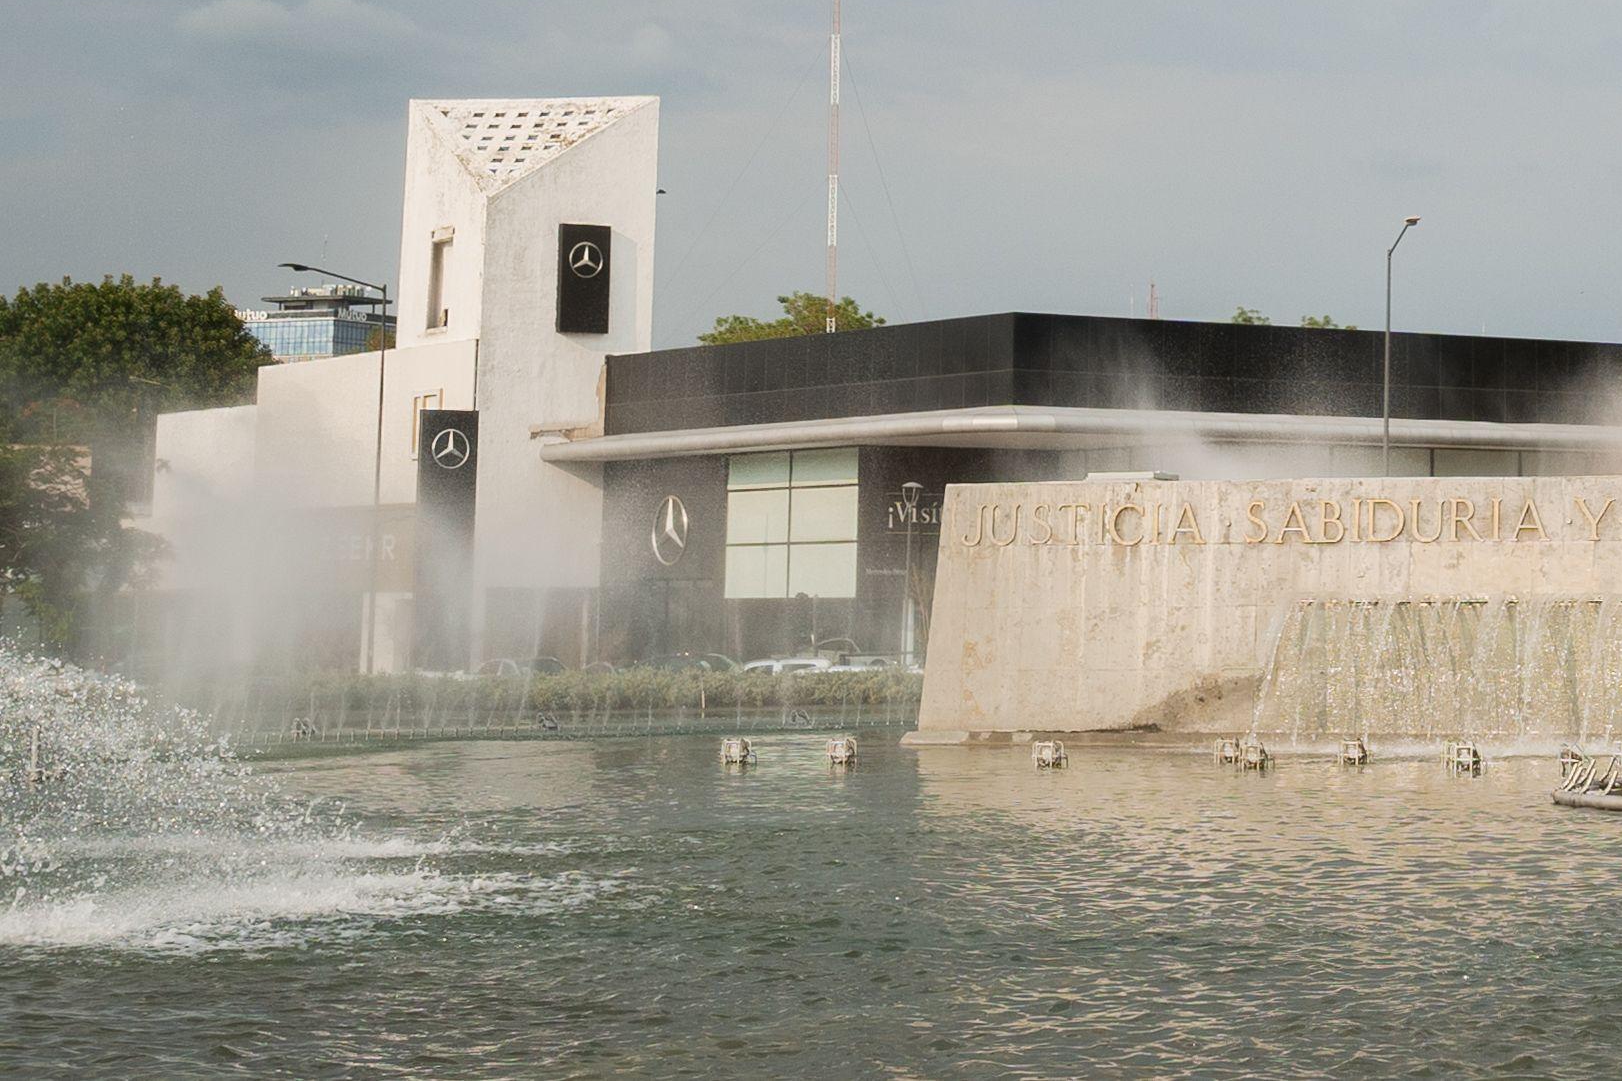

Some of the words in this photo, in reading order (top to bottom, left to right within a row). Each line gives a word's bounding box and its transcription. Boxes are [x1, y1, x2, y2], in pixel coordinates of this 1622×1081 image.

[961, 500, 1207, 547] JUSTICIA
[1243, 497, 1552, 545] SABIDURIA
[1573, 497, 1617, 542] Y
